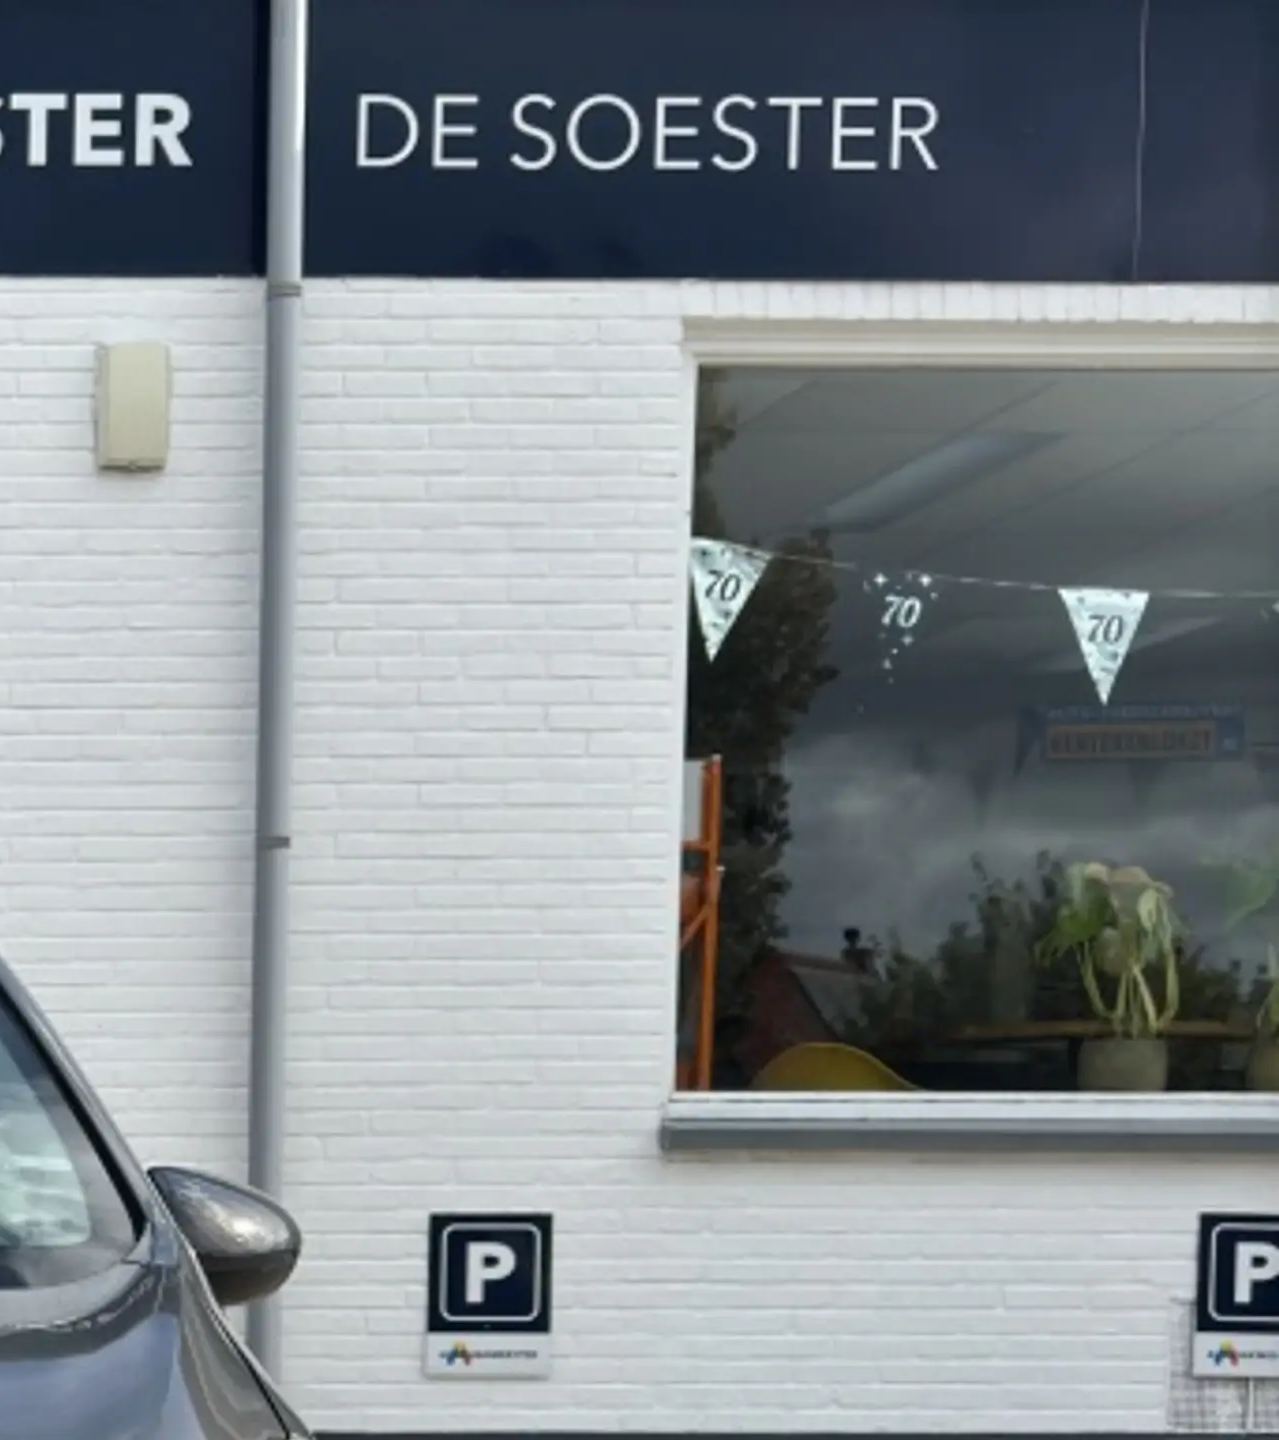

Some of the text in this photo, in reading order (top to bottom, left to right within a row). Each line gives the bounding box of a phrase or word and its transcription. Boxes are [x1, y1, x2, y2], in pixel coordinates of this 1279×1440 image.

[354, 93, 940, 171] DE SOESTER
[704, 567, 742, 602] 70
[880, 594, 924, 629] 70
[1086, 613, 1125, 645] 70
[465, 1240, 517, 1304] P
[1233, 1240, 1279, 1304] P
